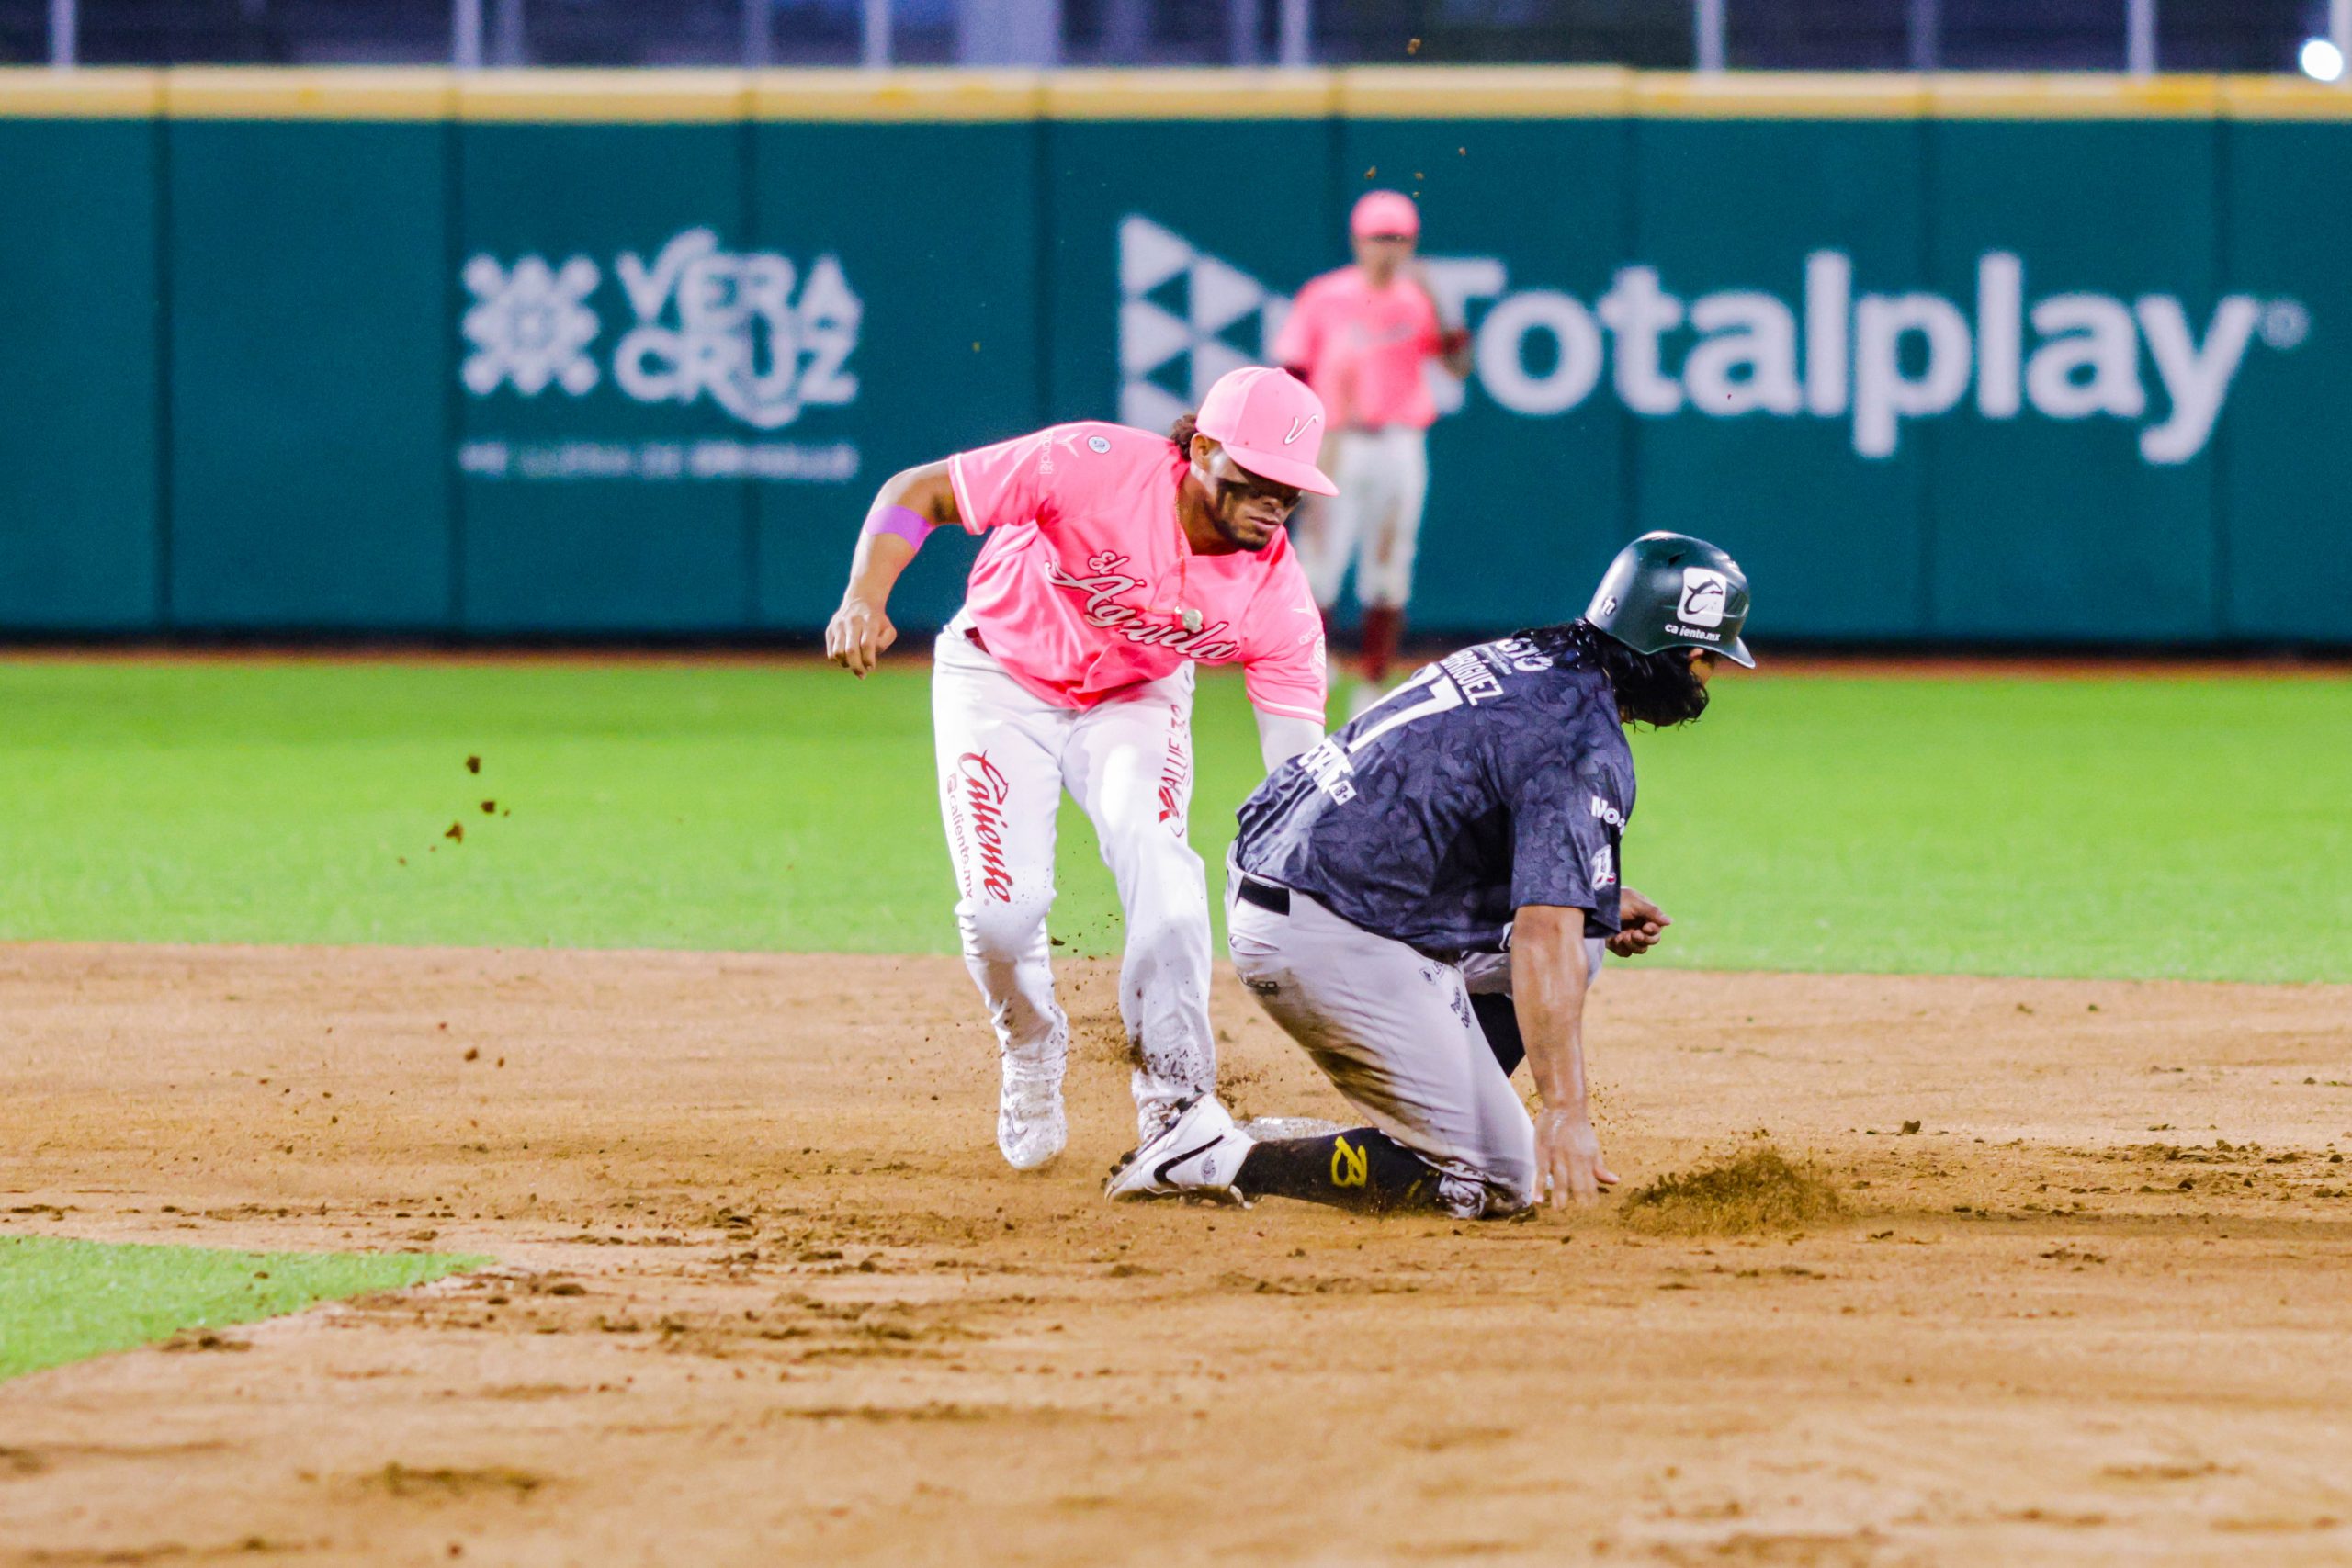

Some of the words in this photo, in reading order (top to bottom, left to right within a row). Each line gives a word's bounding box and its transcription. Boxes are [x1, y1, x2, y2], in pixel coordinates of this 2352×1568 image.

[615, 227, 862, 328] VERA
[614, 310, 858, 428] CRUZ
[1417, 250, 2258, 464] Totalplay
[1088, 551, 1129, 575] El
[949, 795, 974, 898] caliente.mx
[958, 749, 1013, 903] Caliente
